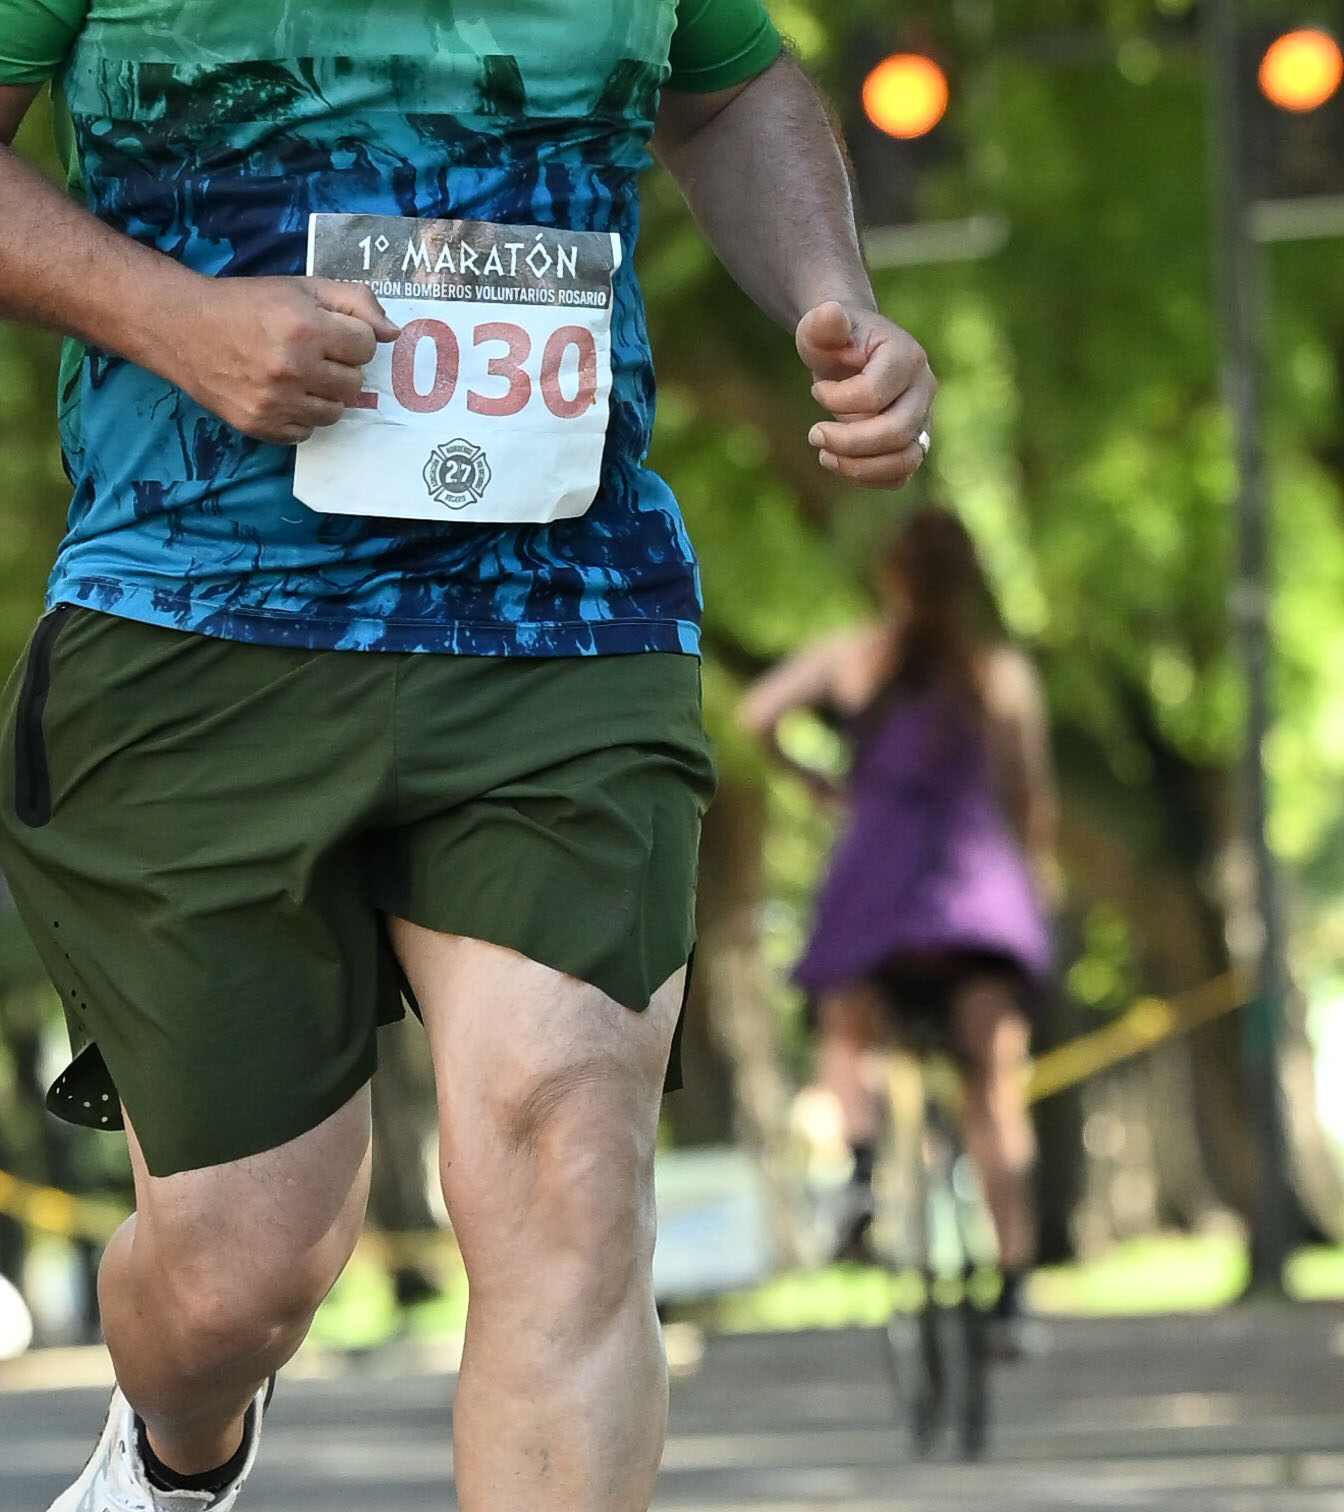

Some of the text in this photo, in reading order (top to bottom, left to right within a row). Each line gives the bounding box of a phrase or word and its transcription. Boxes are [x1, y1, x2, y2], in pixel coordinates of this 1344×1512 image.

[402, 232, 578, 280] MARATÓN
[405, 282, 472, 300] BOMBEROS
[475, 285, 555, 304] VOLUNTARIOS
[558, 289, 607, 306] ROSARIO
[345, 318, 597, 418] 030
[445, 460, 472, 484] 27
